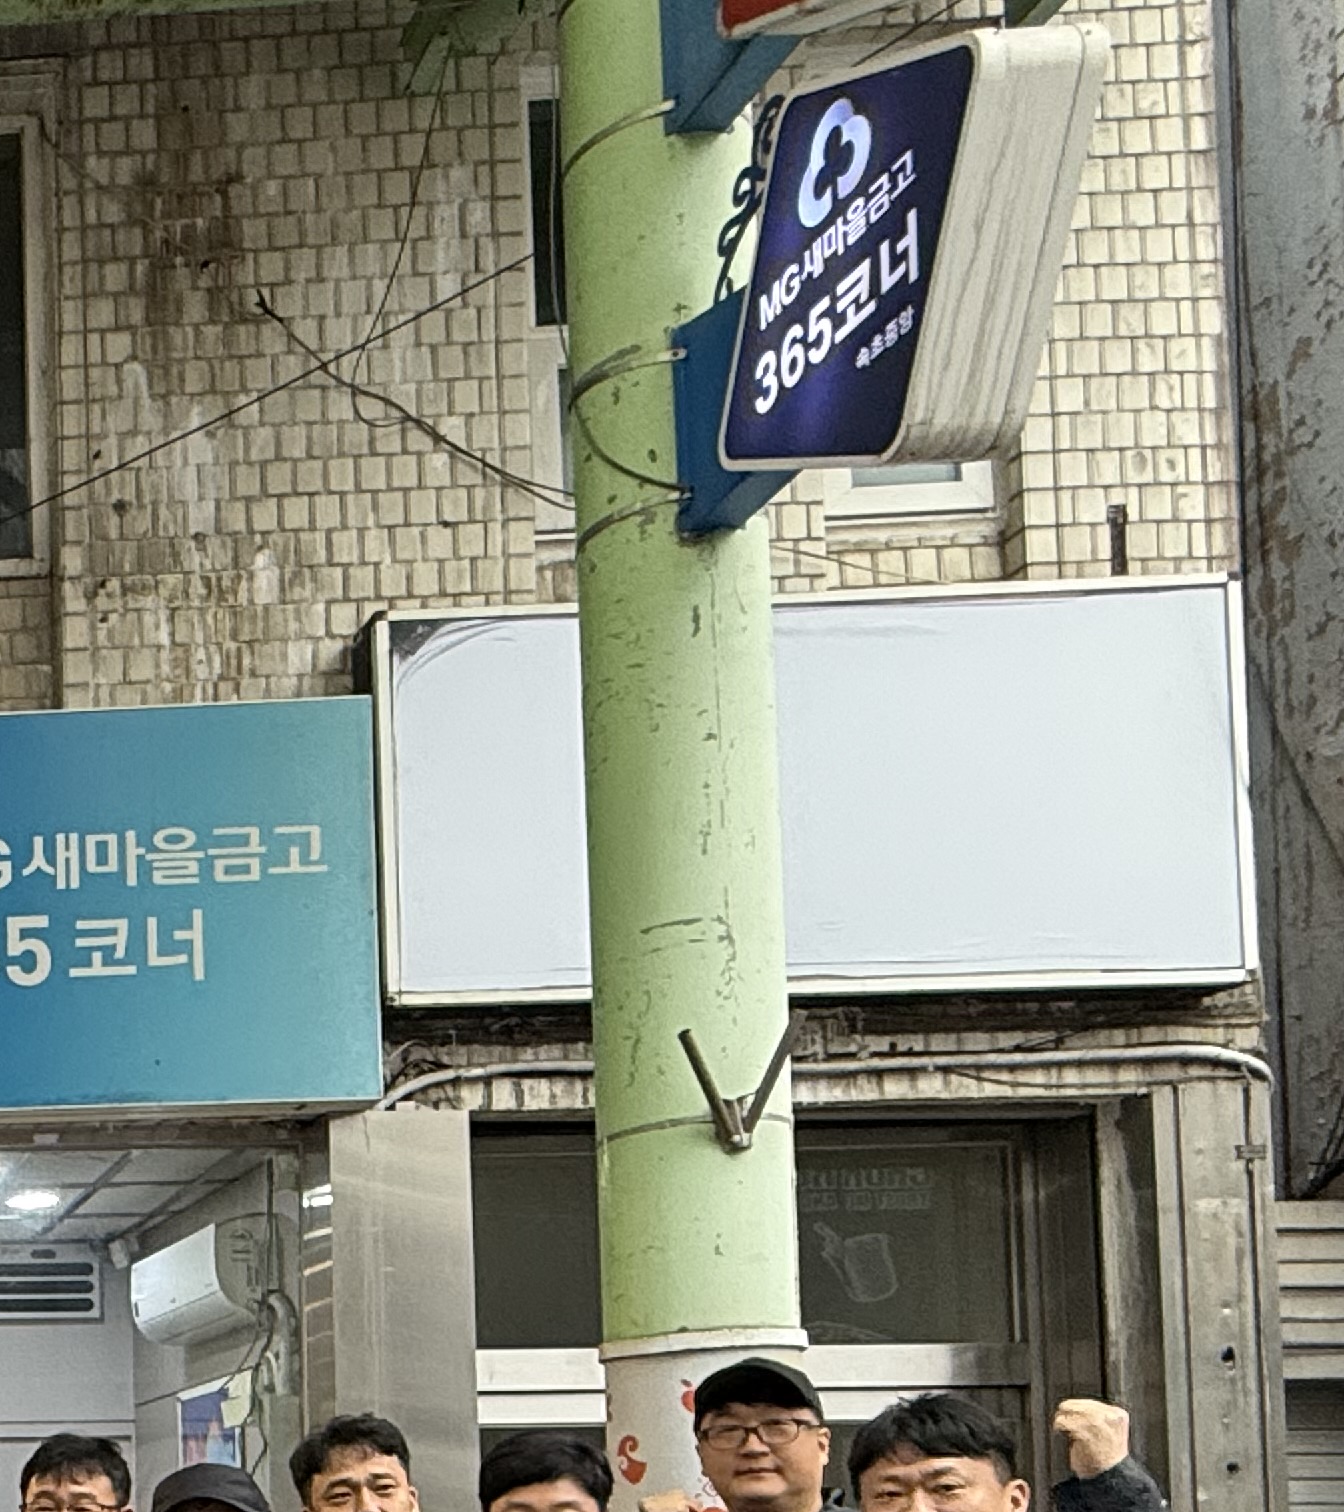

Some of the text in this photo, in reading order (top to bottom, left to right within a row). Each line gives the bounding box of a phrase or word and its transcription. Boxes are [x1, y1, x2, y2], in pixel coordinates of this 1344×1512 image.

[754, 208, 920, 414] 365코너
[758, 150, 917, 330] MG새마을금고
[67, 910, 207, 982] 코너
